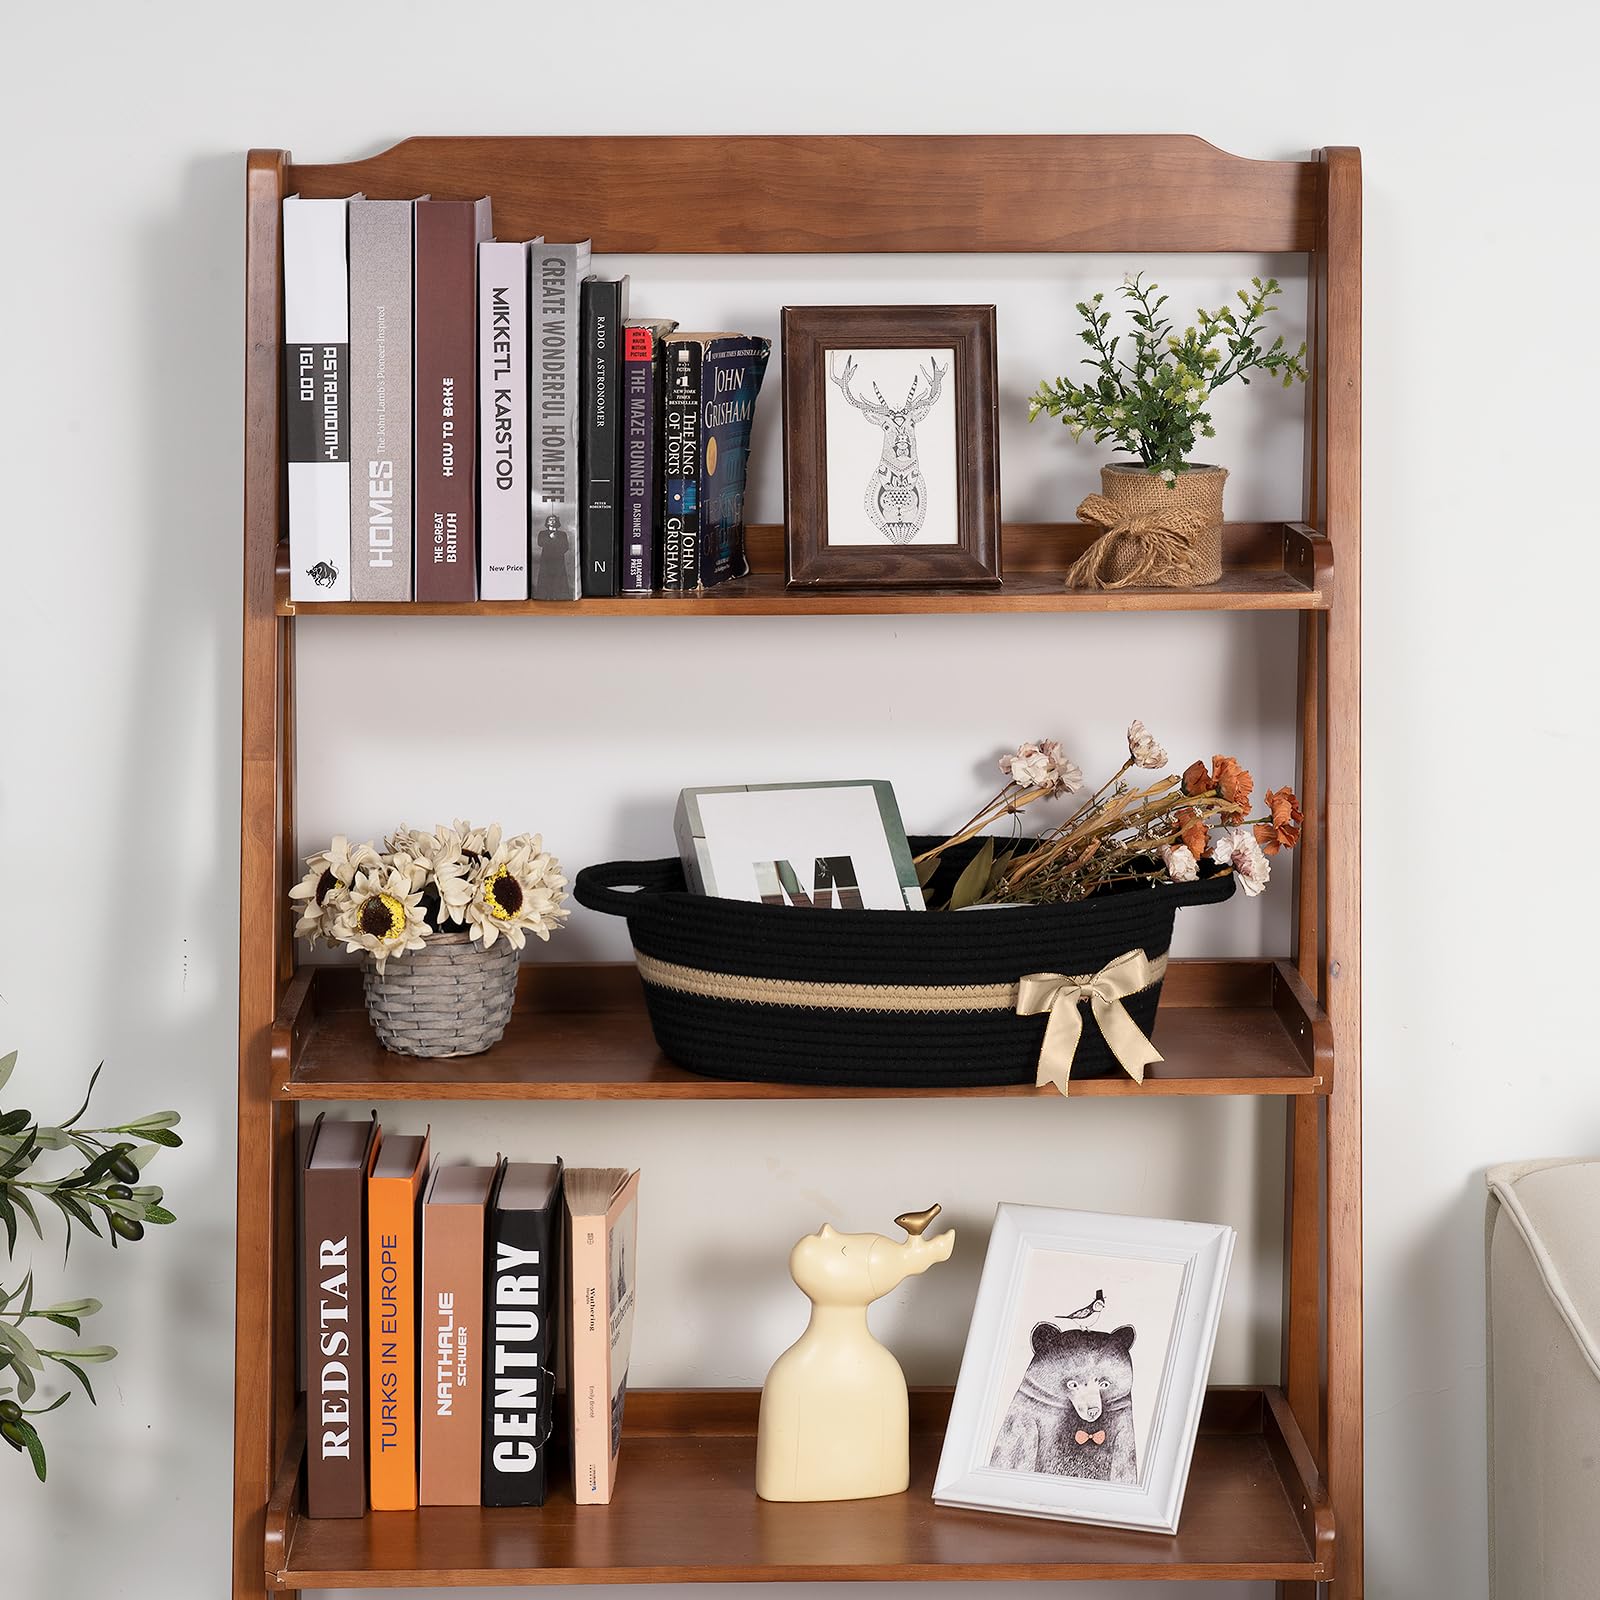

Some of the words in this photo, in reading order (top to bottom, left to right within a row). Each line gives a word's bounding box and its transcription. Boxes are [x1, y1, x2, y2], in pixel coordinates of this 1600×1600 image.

[541, 257, 566, 315] CREATE
[492, 287, 511, 381] MIKKETL
[596, 316, 606, 350] RADIO
[299, 347, 314, 401] IGLOO
[541, 320, 566, 419] WONDERFUL
[630, 368, 646, 394] THE
[713, 366, 746, 402] JOHN
[323, 347, 339, 460] ASTRONOMY
[442, 377, 454, 417] BAKE
[596, 357, 606, 428] ASTRONOMER
[377, 414, 386, 436] John
[442, 421, 454, 439] TO
[630, 398, 646, 436] MAZE
[668, 412, 681, 430] OF
[682, 411, 697, 438] THE
[704, 399, 752, 429] GRISHAM
[377, 437, 386, 453] The
[442, 442, 454, 478] HOW
[494, 389, 513, 491] KARSTOD
[668, 432, 683, 475] TORTS
[682, 440, 697, 475] KING
[541, 425, 566, 503] HOMELIFE
[629, 440, 645, 497] RUNNER
[368, 460, 393, 568] HOMES
[434, 512, 444, 544] GREAT
[632, 503, 642, 538] DASHNER
[434, 546, 444, 564] THE
[446, 512, 457, 563] BRITISH
[666, 517, 682, 584] GRISHAM
[679, 532, 697, 570] JOHN
[594, 560, 606, 573] N
[381, 1233, 398, 1334] EUROPE
[319, 1235, 350, 1461] REDSTAR
[381, 1342, 397, 1364] IN
[436, 1292, 454, 1416] NATHALIE
[457, 1326, 468, 1387] SCHWER
[492, 1241, 540, 1473] CENTURY
[381, 1372, 398, 1453] TURKS
